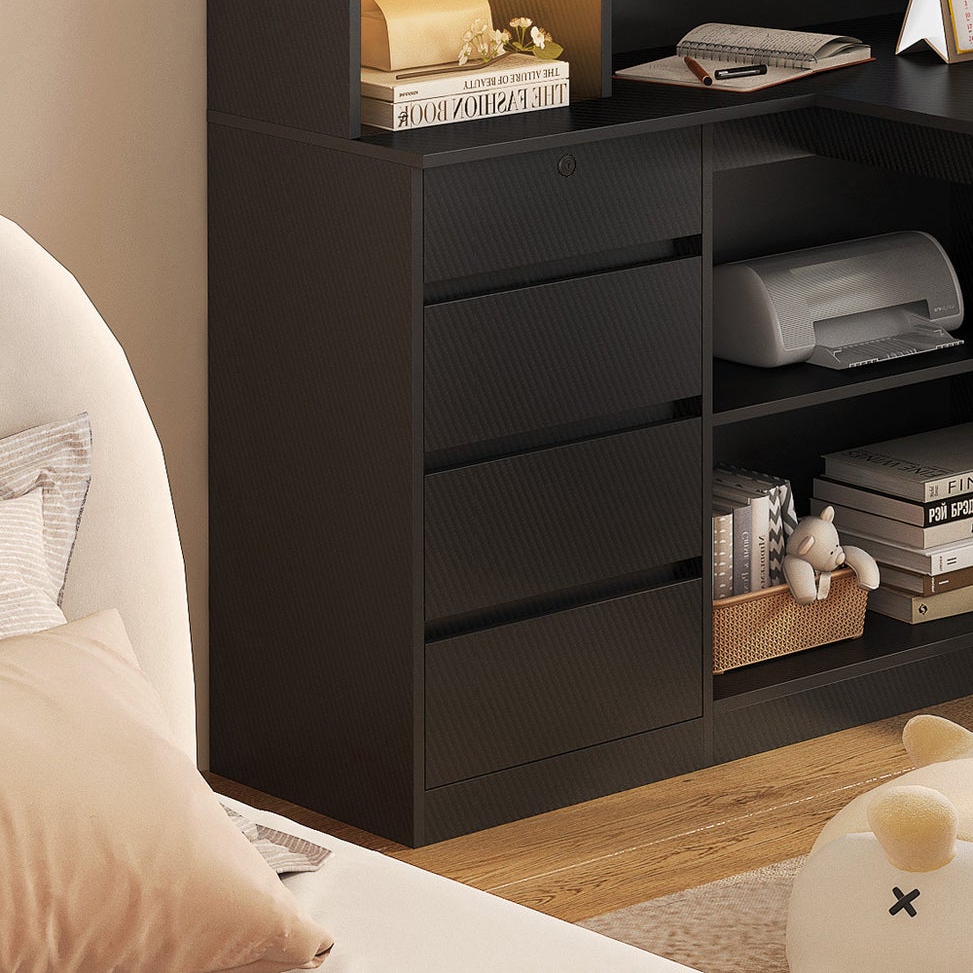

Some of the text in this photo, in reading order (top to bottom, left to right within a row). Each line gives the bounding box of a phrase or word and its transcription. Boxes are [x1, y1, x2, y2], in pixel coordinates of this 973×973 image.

[463, 67, 560, 90] THE ALLURE OF BEAUTY
[928, 502, 948, 524] РЭЙ
